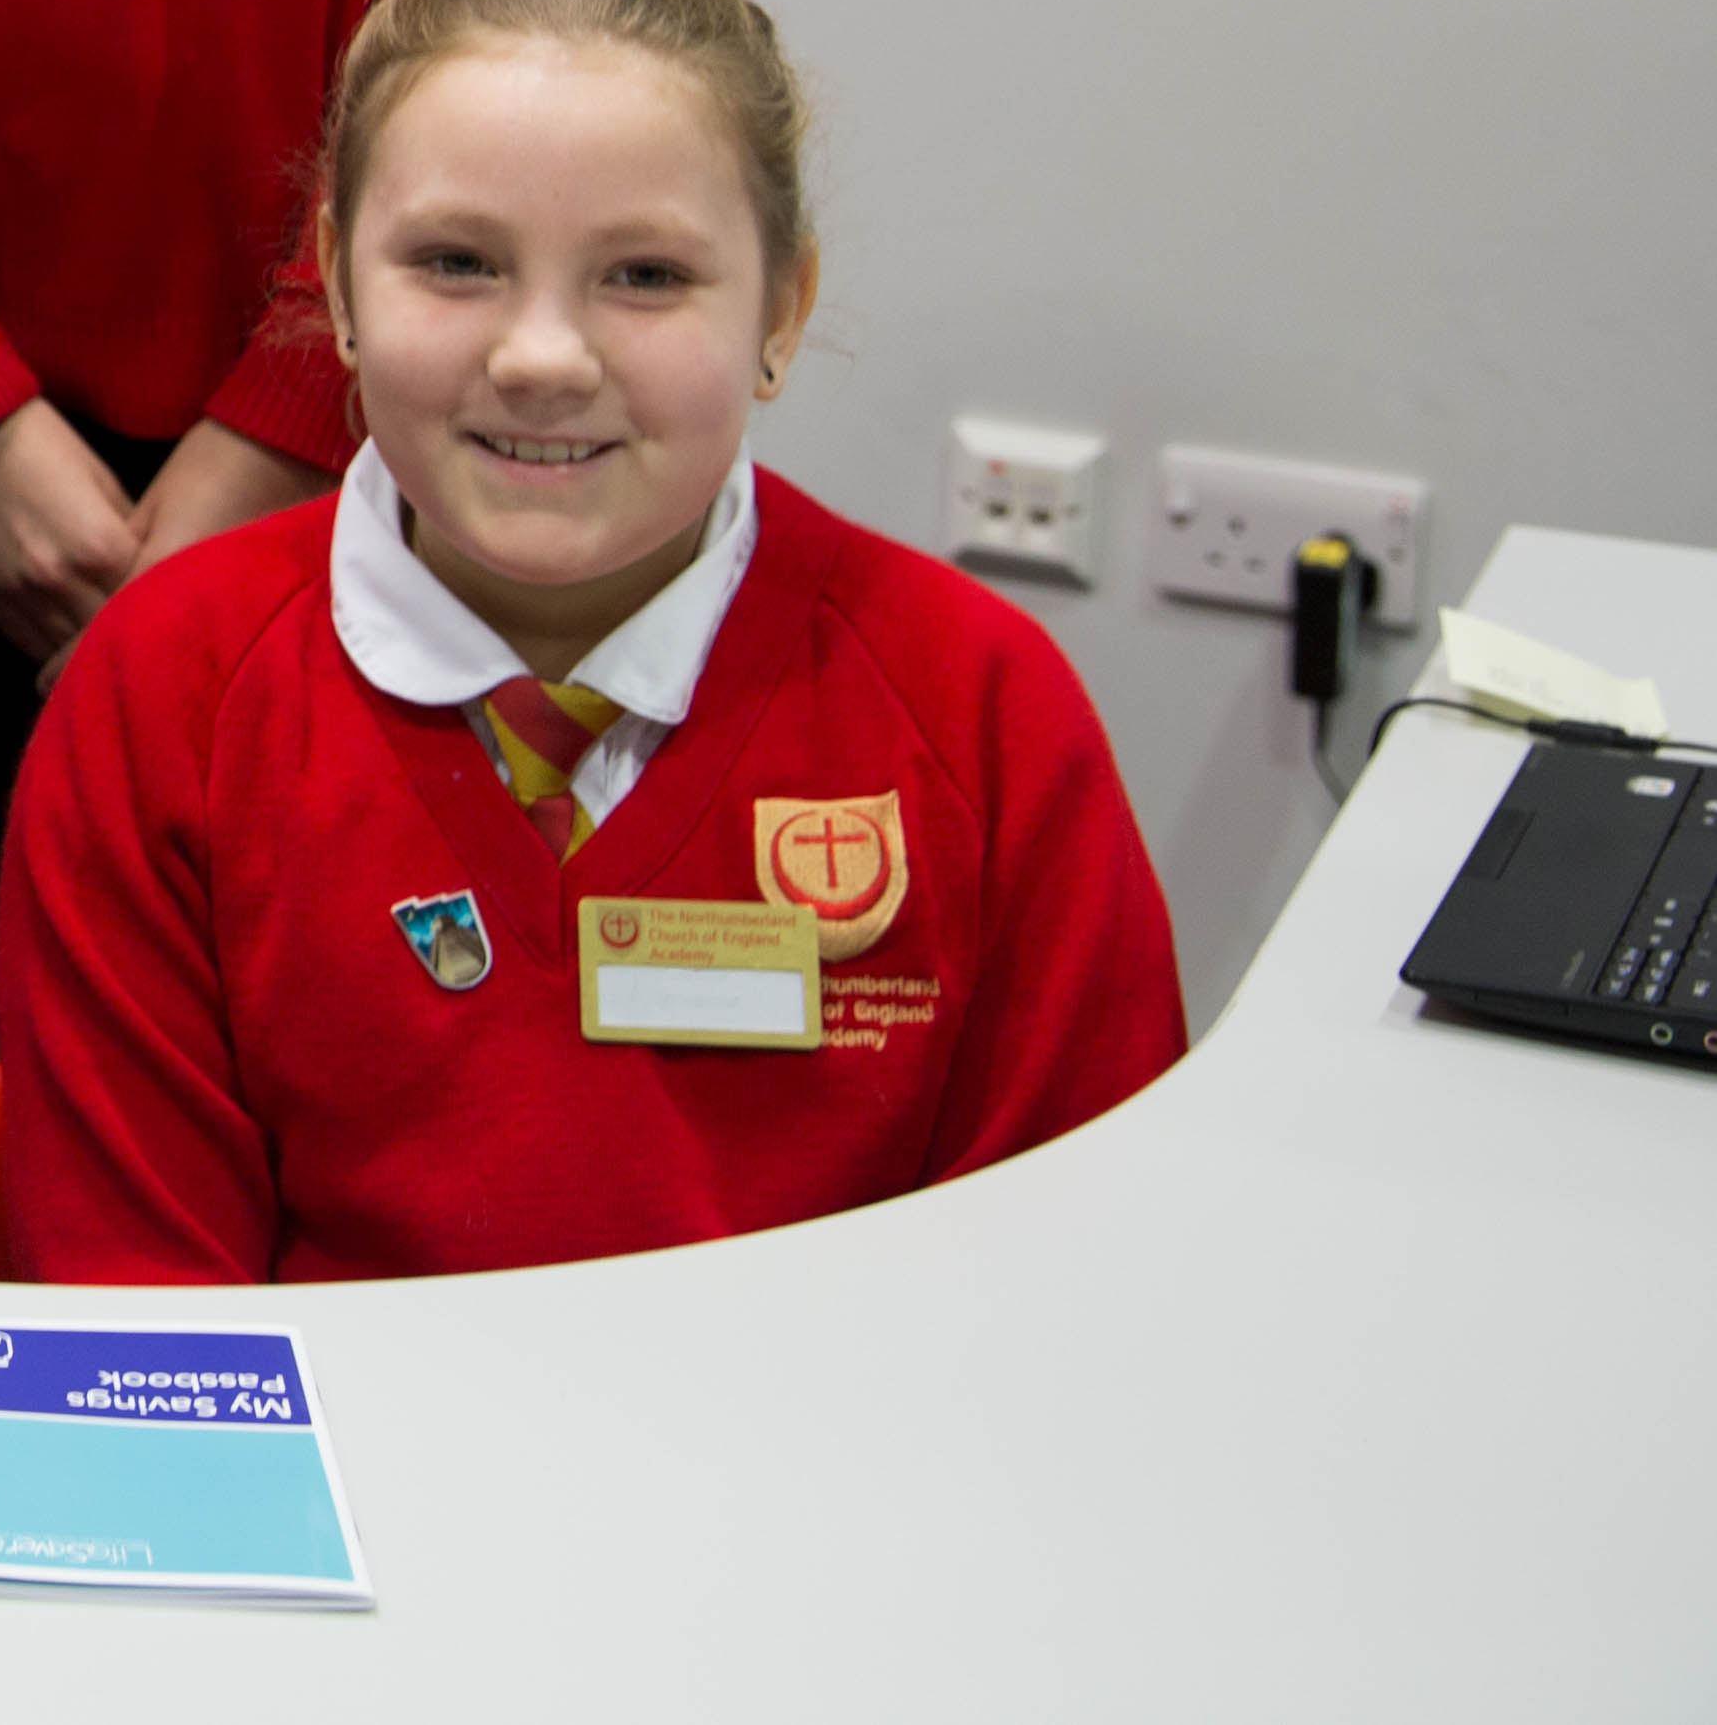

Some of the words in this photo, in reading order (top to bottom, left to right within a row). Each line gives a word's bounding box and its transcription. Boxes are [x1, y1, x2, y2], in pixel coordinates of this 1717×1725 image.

[649, 909, 676, 924] The
[678, 909, 798, 928] Northumberland
[648, 929, 700, 945] Church
[702, 929, 719, 945] of
[723, 930, 782, 948] England
[648, 947, 715, 965] Academy
[822, 975, 940, 998] humberland
[824, 1000, 845, 1021] of
[853, 999, 935, 1027] England
[821, 1026, 888, 1052] ademy
[97, 1369, 286, 1395] Passbook
[66, 1388, 218, 1418] Savings
[230, 1391, 292, 1419] My
